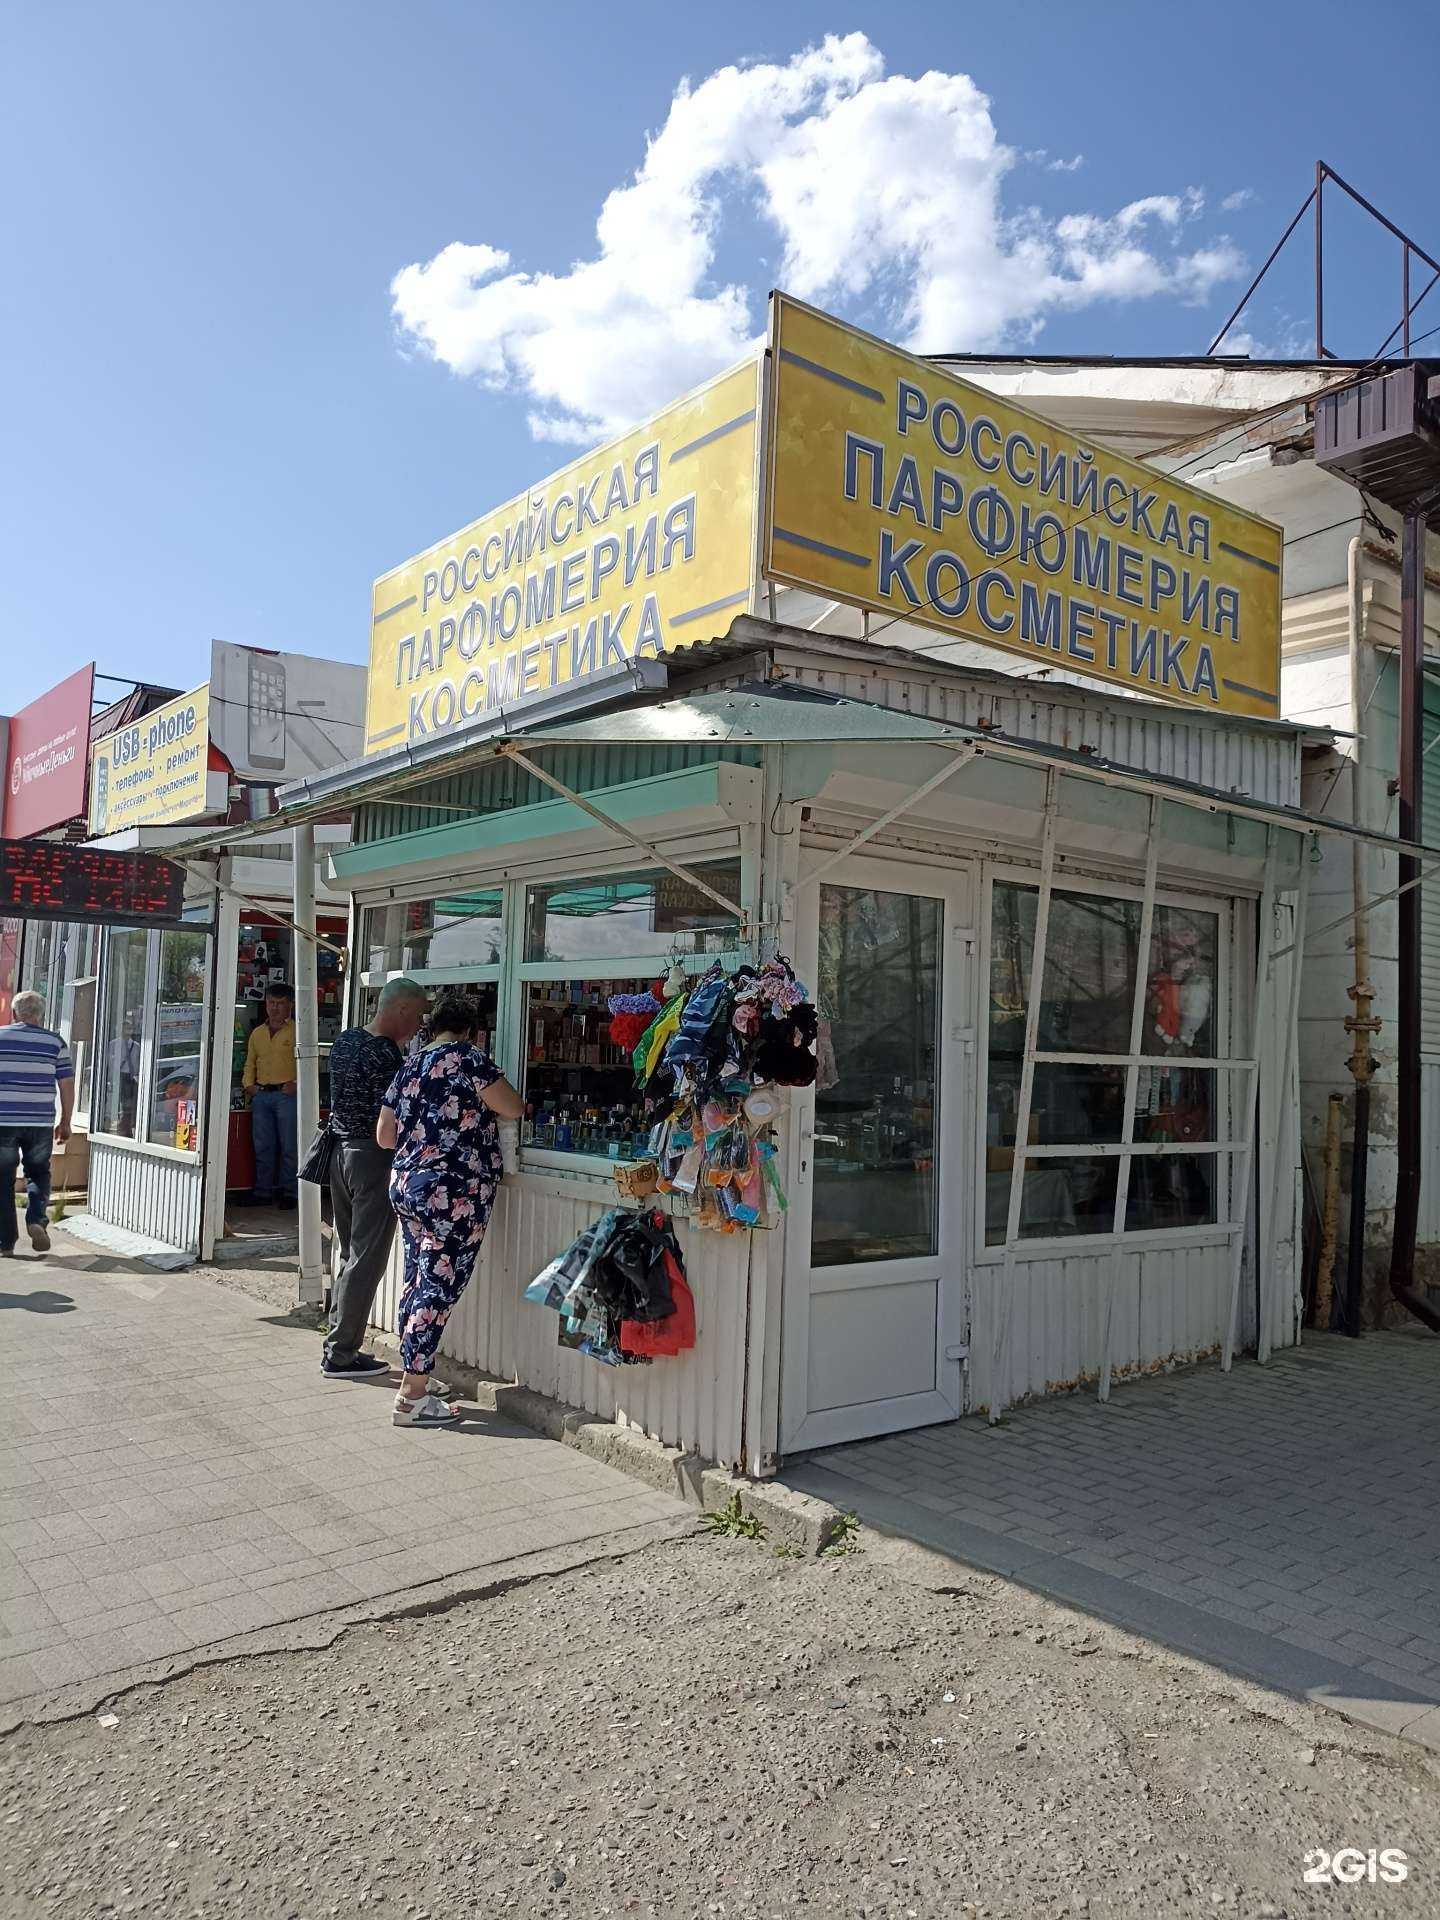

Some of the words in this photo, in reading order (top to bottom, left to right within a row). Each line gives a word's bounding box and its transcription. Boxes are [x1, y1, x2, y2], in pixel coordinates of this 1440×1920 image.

[421, 439, 661, 614] РОССИЙСКАЯ
[843, 430, 1241, 643] ПАРФЮМЕРИЯ
[896, 376, 1212, 562] РОССИЙСКАЯ
[395, 492, 698, 688] ПАРФЮМЕРИЯ
[409, 592, 665, 739] КОСМЕТИКА
[877, 528, 1220, 702] КОСМЕТИКА
[115, 766, 155, 791] телефоны
[166, 743, 200, 774] ремонт
